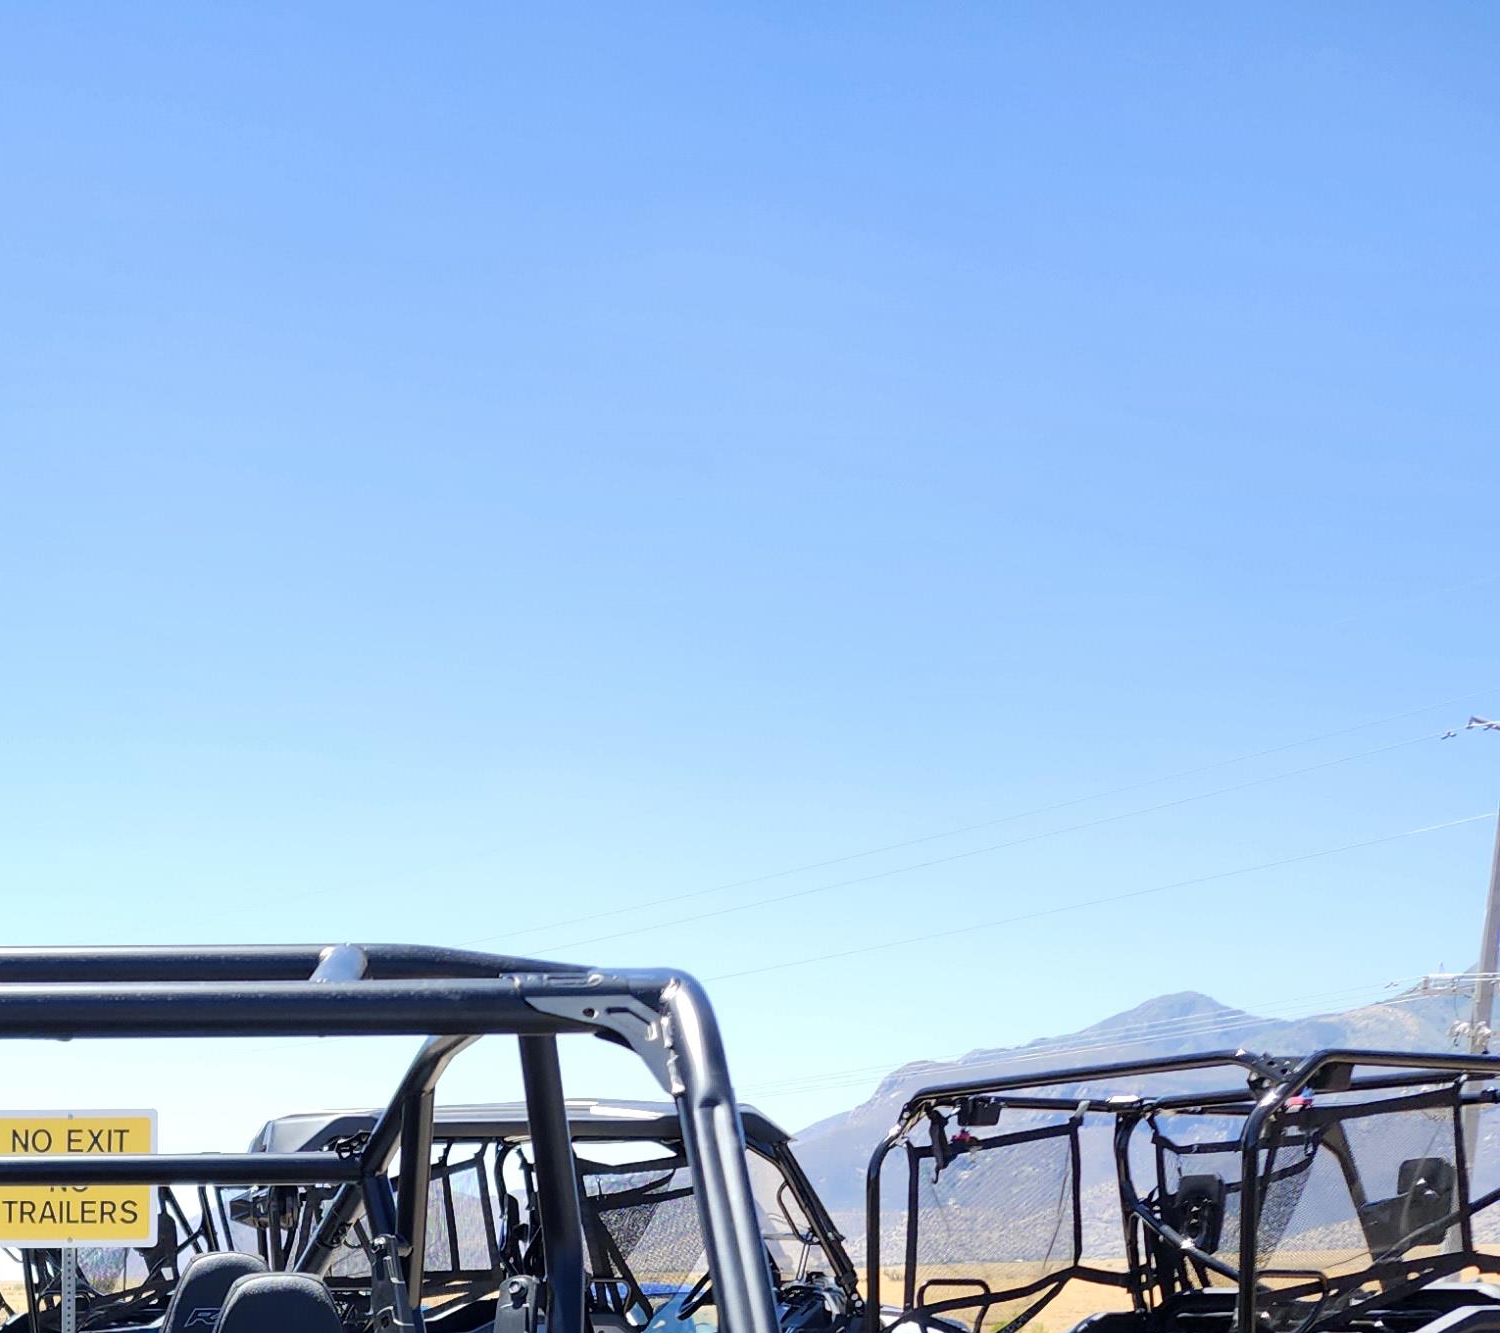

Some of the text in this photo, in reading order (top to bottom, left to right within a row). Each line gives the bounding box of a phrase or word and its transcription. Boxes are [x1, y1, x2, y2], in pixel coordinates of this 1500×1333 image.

[11, 1128, 130, 1153] NO EXIT
[2, 1200, 138, 1224] TRAILERS
